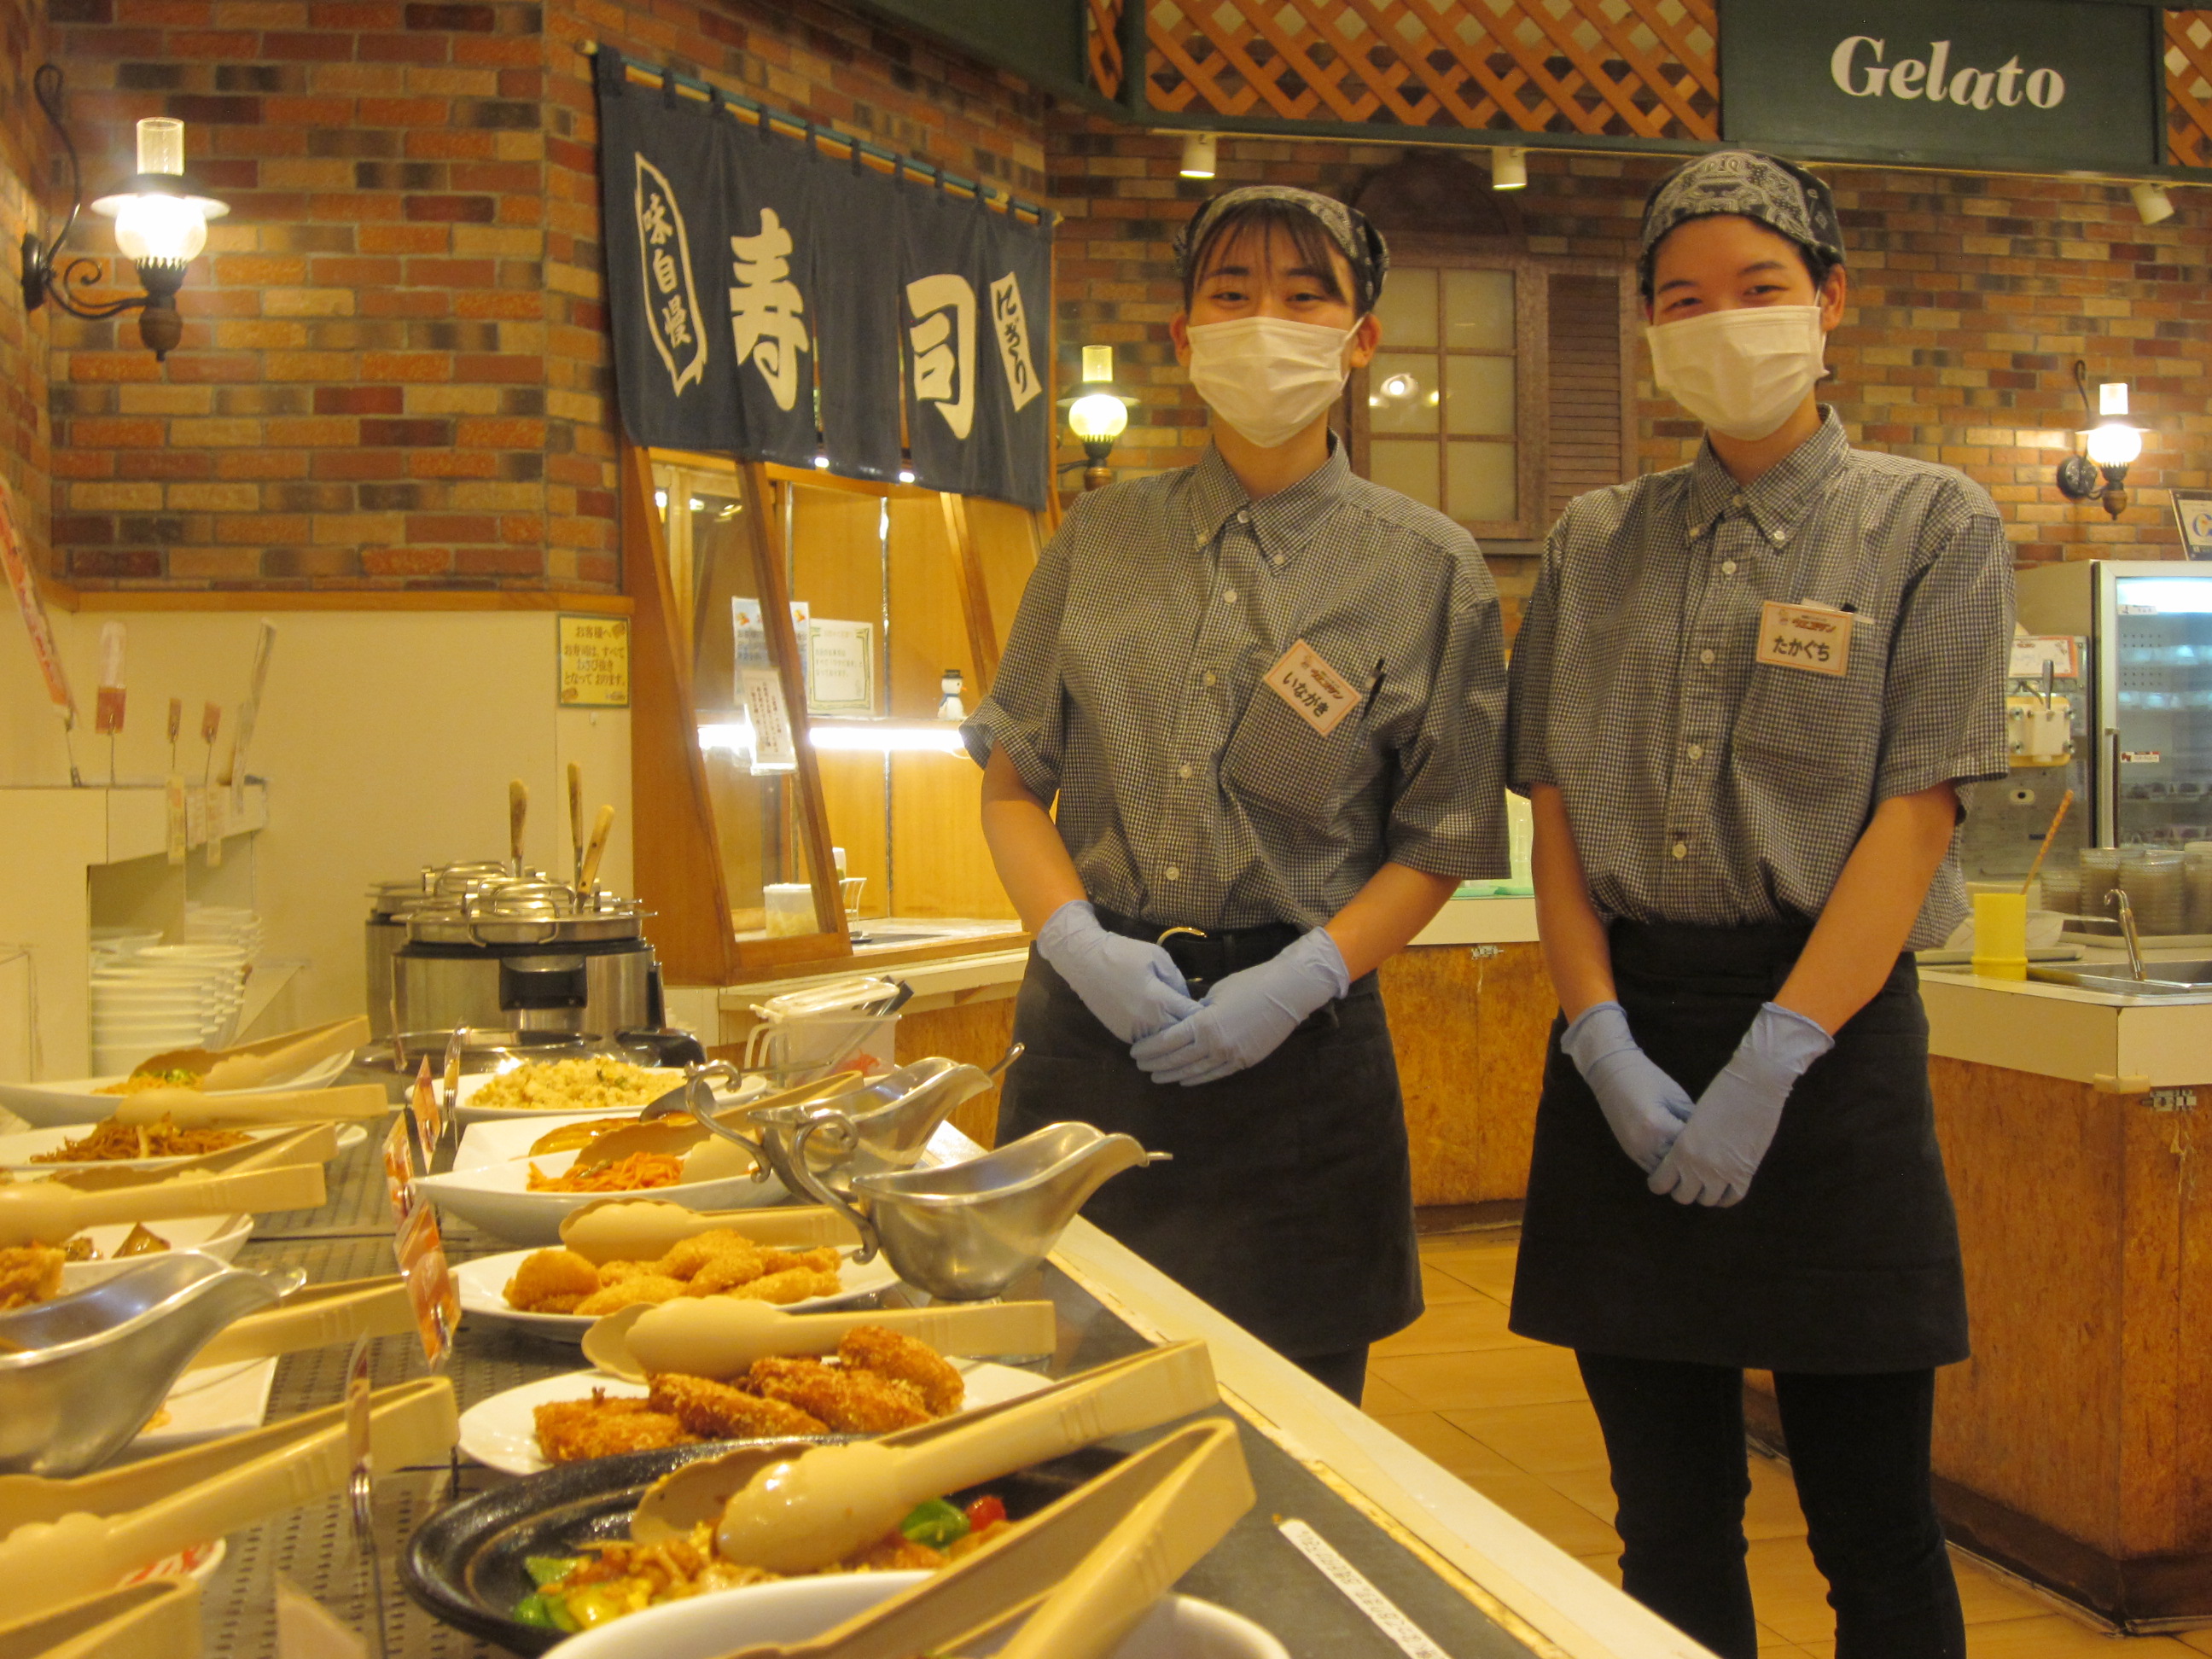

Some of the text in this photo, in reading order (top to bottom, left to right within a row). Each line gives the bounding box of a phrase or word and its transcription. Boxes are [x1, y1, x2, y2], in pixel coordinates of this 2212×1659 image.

[1831, 35, 2066, 110] Gelato
[643, 193, 692, 348] 味自慢
[996, 283, 1027, 394] にぎり
[1773, 635, 1830, 662] たかぐち
[1282, 671, 1330, 718] いながき
